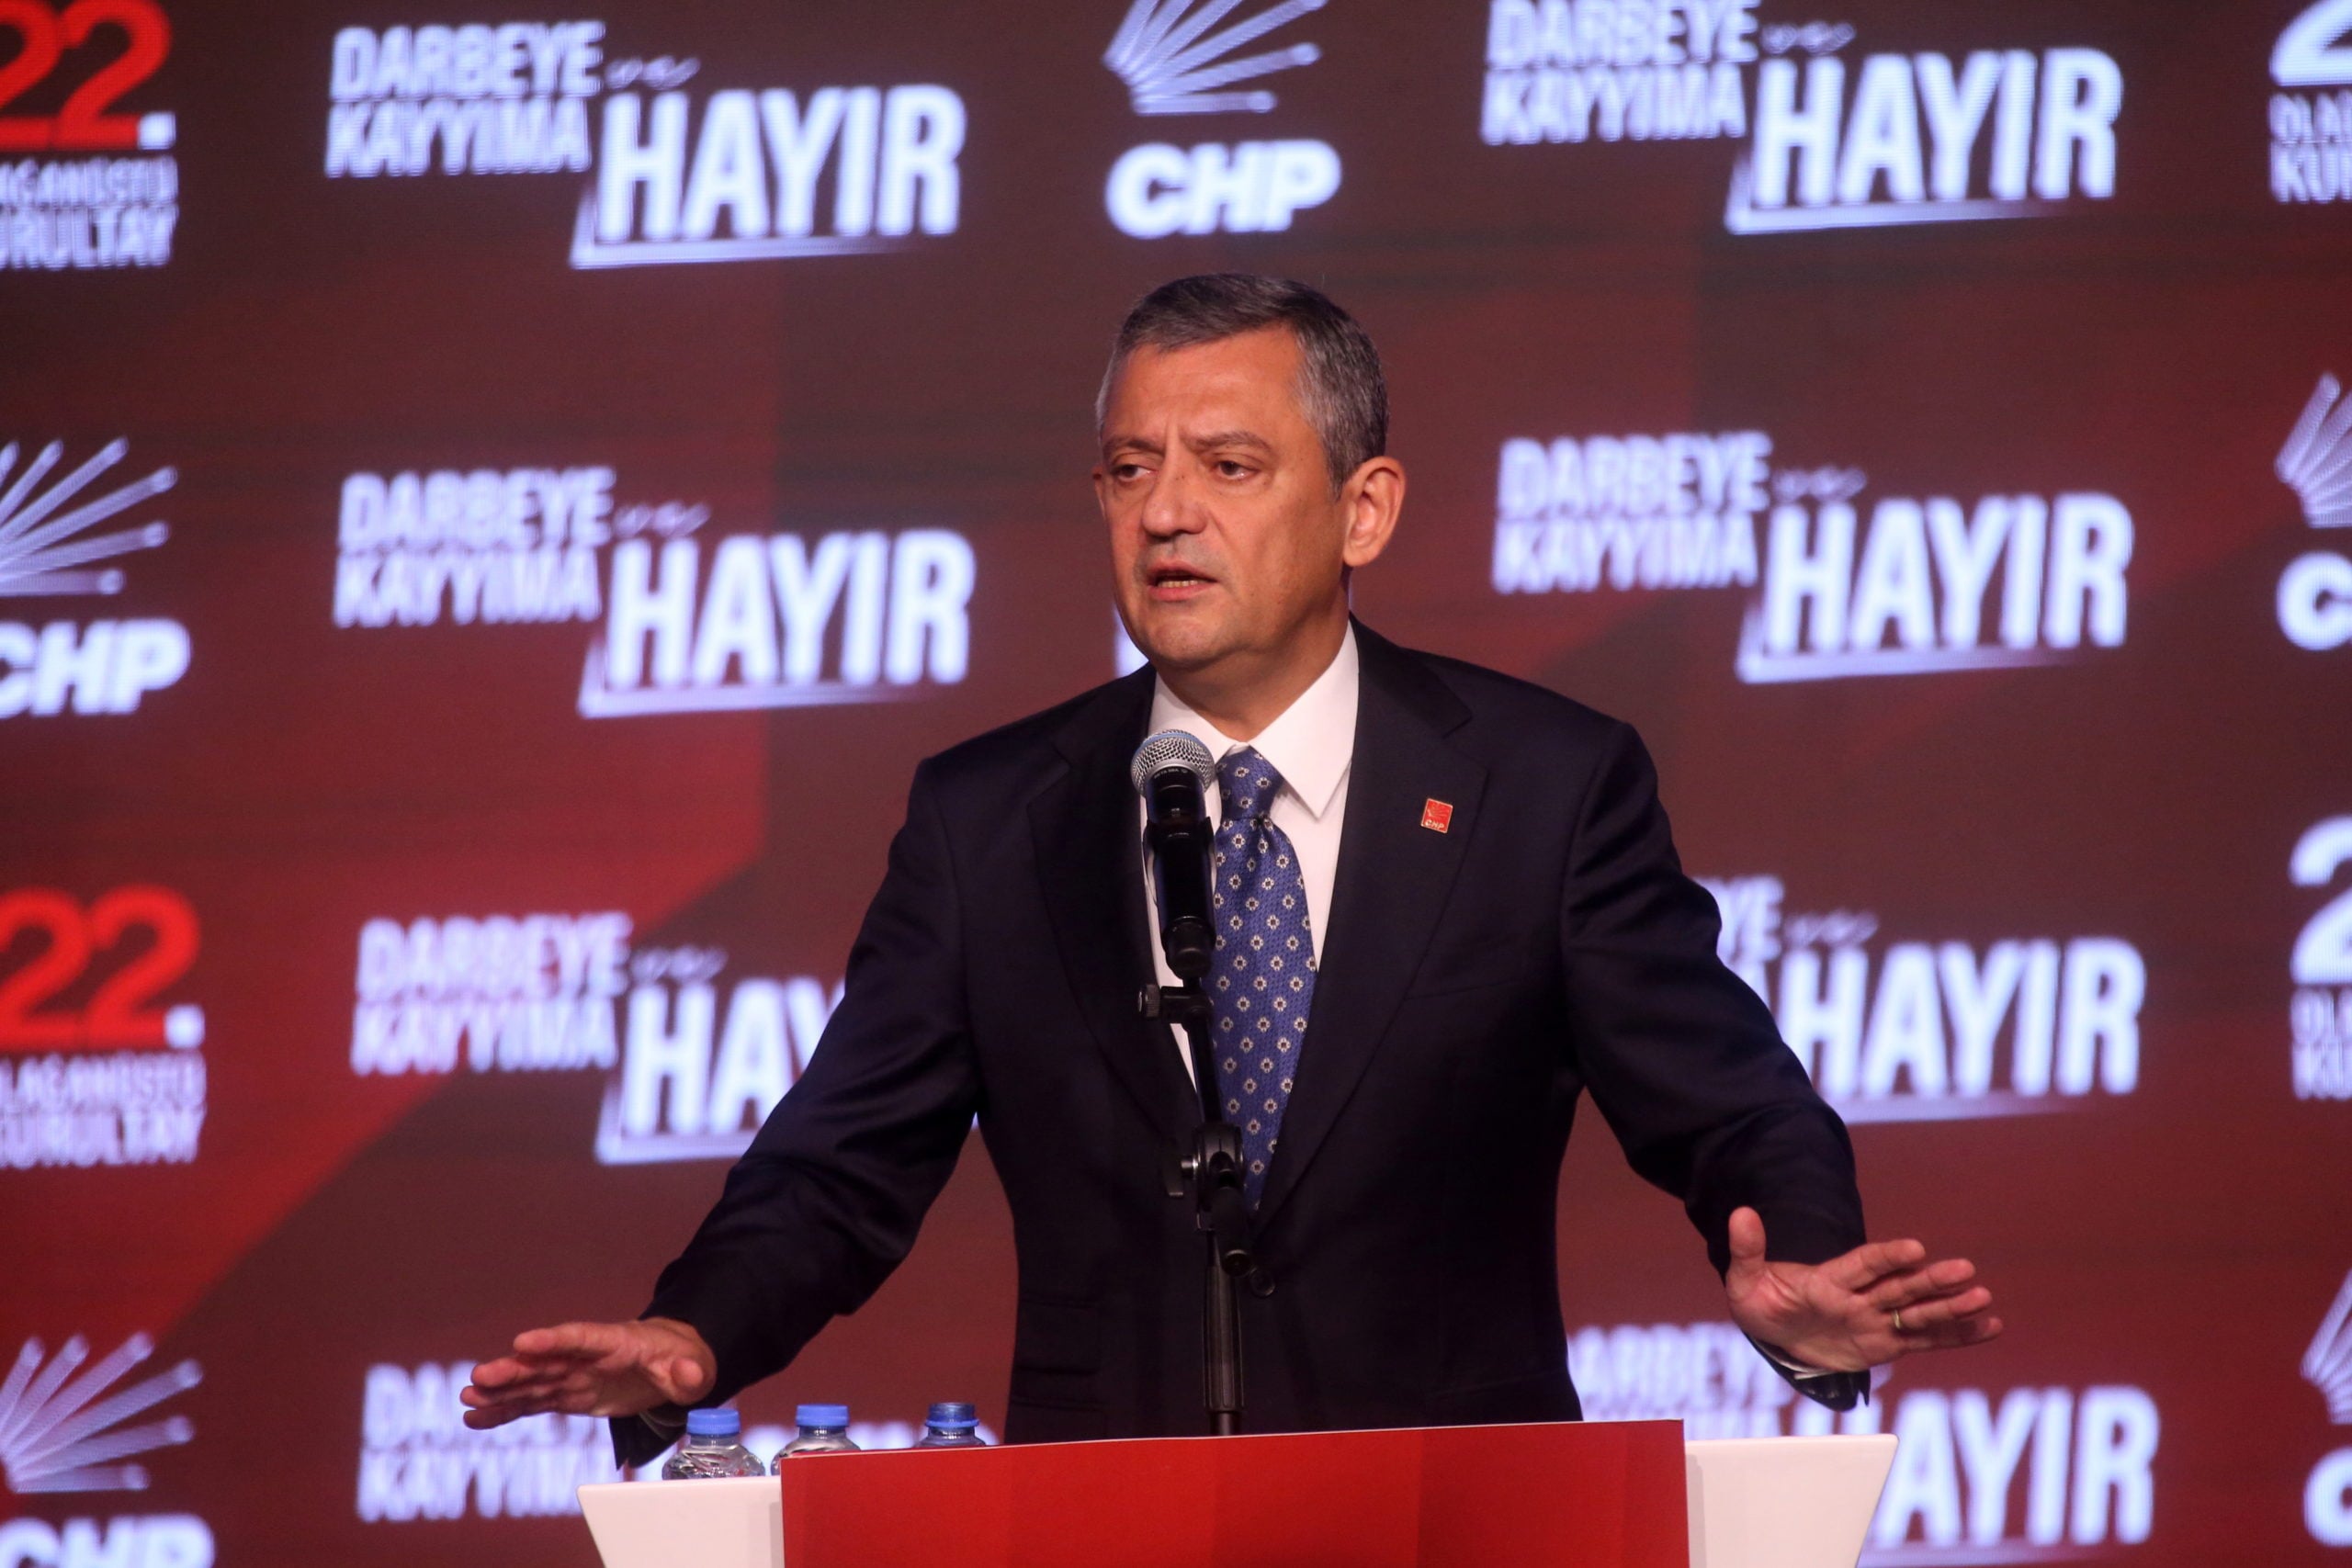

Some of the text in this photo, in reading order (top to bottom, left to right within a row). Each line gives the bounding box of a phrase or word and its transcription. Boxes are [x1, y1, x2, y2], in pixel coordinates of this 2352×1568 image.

[329, 20, 606, 98] DARBEYE
[1485, 0, 1763, 66] DARBEYE
[324, 95, 591, 179] KAYYIMA
[1480, 64, 1747, 146] KAYYIMA
[1747, 48, 2124, 206] HAYIR
[598, 84, 968, 242] HAYIR
[1105, 139, 1343, 240] CHP
[337, 466, 616, 548] DARBEYE
[1495, 430, 1773, 514] DARBEYE
[333, 545, 602, 628] KAYYIMA
[1491, 511, 1758, 595] KAYYIMA
[1763, 491, 2136, 655] HAYIR
[605, 527, 978, 690] HAYIR
[355, 911, 633, 1000] DARBEYE
[350, 992, 618, 1076] KAYYIMA
[1771, 936, 2147, 1100] HAYIR
